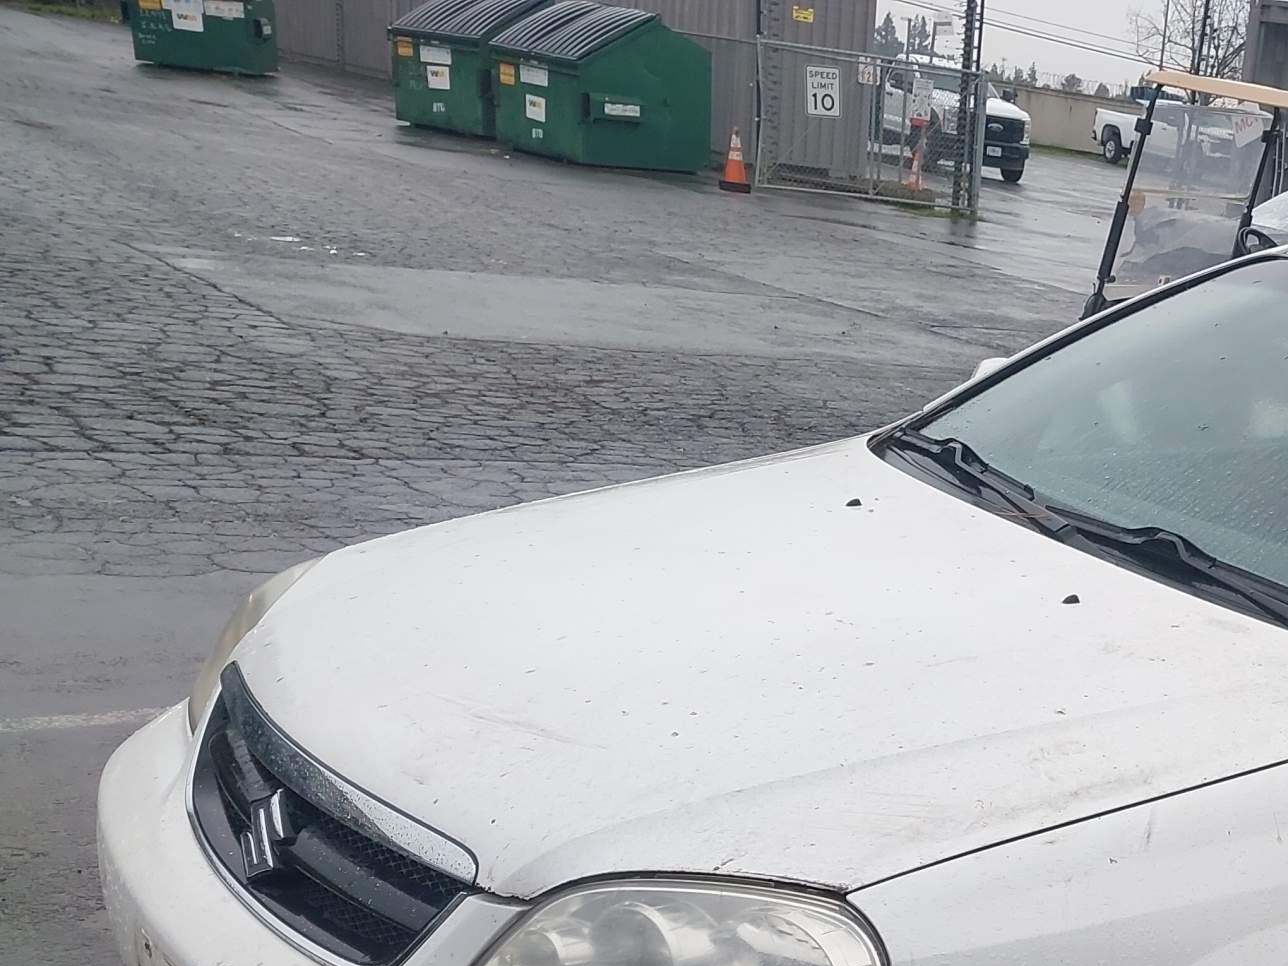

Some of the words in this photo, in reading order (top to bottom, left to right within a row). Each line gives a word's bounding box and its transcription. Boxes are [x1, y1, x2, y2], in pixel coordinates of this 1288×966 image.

[808, 70, 837, 80] SPEED
[811, 82, 834, 90] LIMIT
[811, 92, 835, 111] 10
